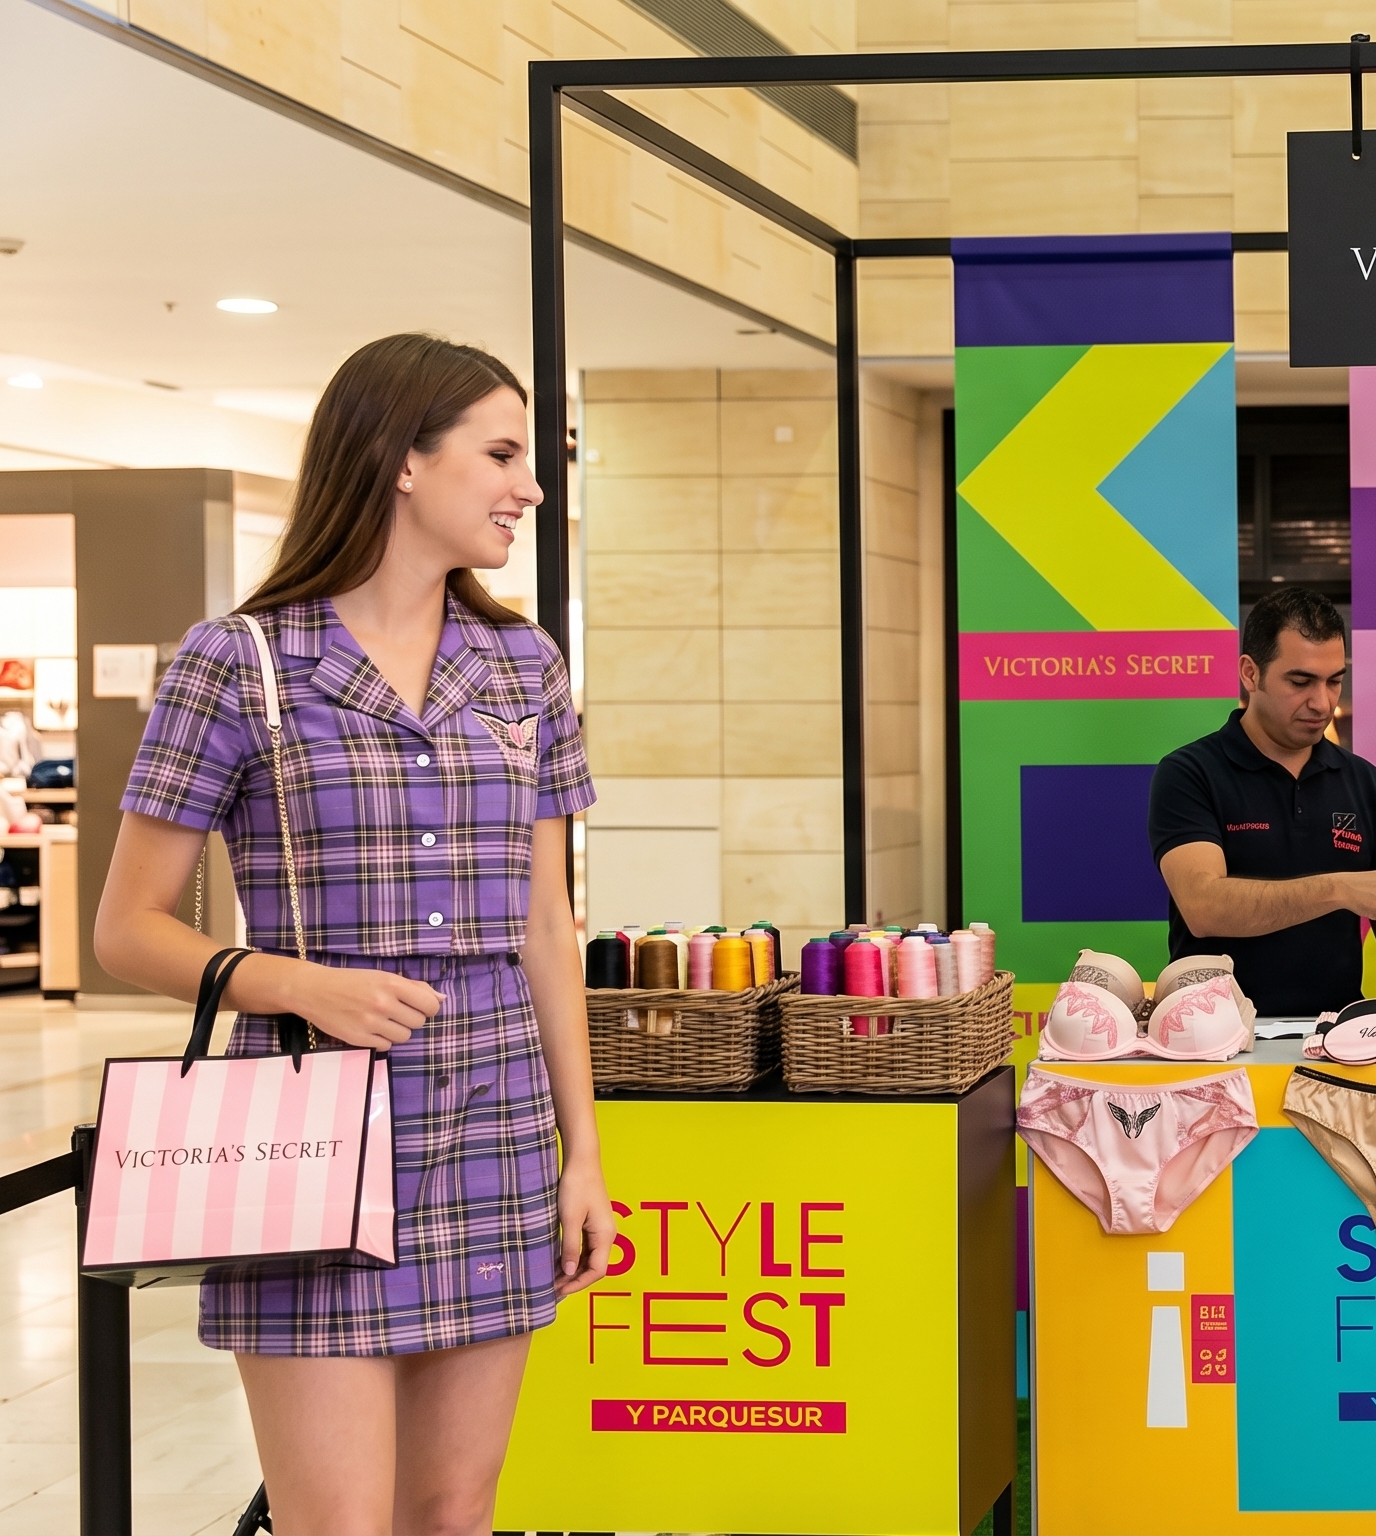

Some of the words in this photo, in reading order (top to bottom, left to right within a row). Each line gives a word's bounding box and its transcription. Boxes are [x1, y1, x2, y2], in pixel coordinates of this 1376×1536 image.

[983, 655, 1117, 677] VICTORIA'S
[1126, 654, 1215, 675] SECRET
[114, 1143, 246, 1170] VICTORIA'S
[255, 1139, 344, 1163] SECRET
[589, 1292, 846, 1368] FEST
[626, 1404, 646, 1425] Y
[652, 1404, 823, 1429] PARQUESUR
